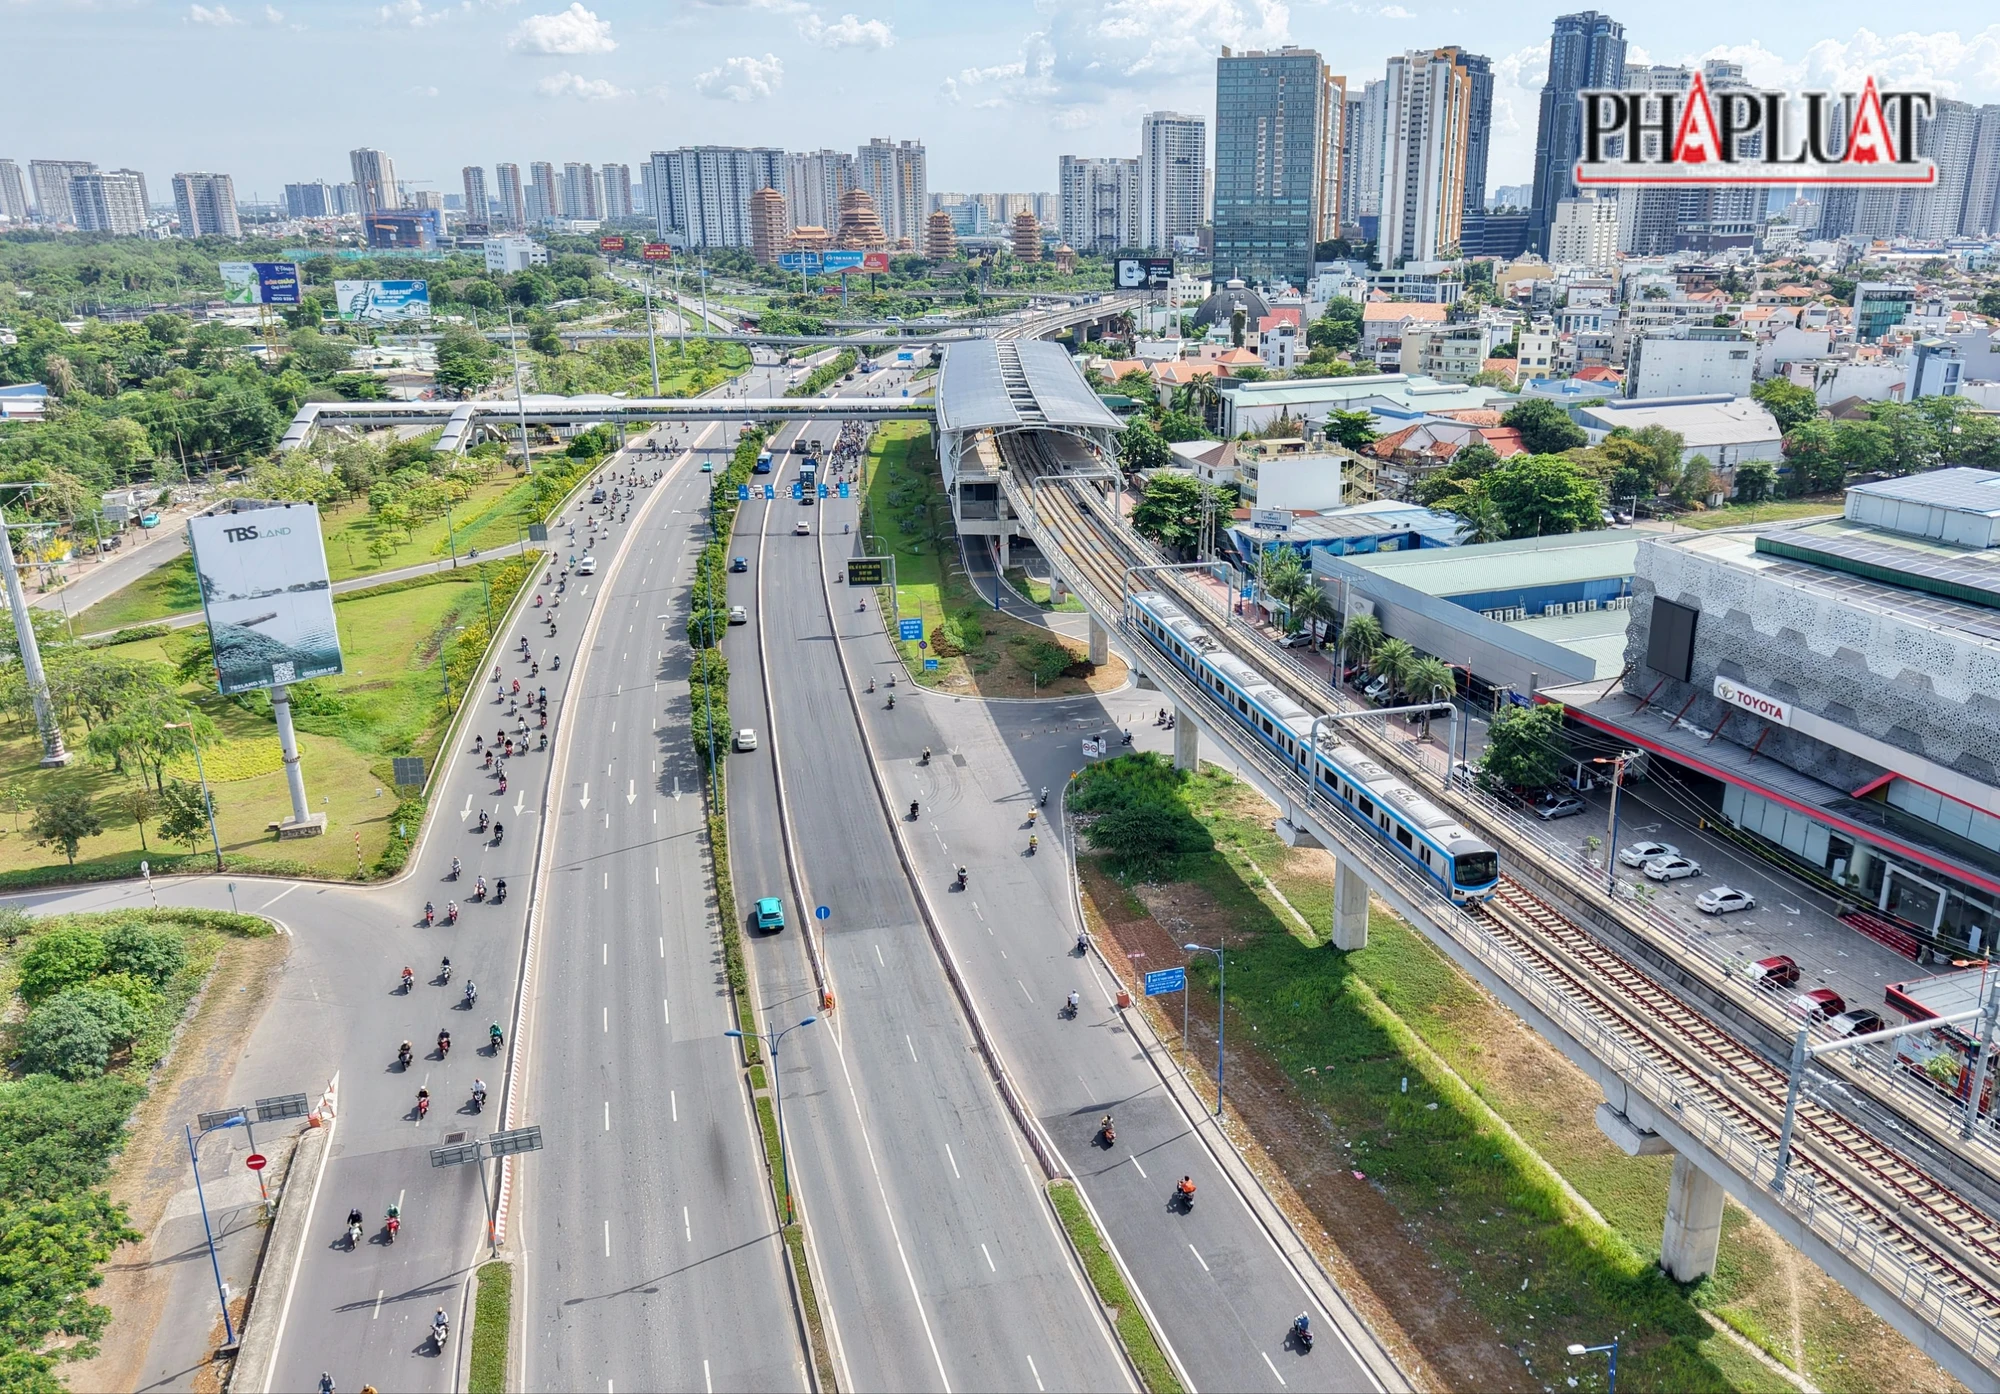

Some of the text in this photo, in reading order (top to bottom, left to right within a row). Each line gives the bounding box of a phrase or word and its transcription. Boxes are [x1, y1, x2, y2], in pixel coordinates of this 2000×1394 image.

[223, 525, 291, 543] TBS LAND
[1737, 690, 1783, 720] TOYOTA
